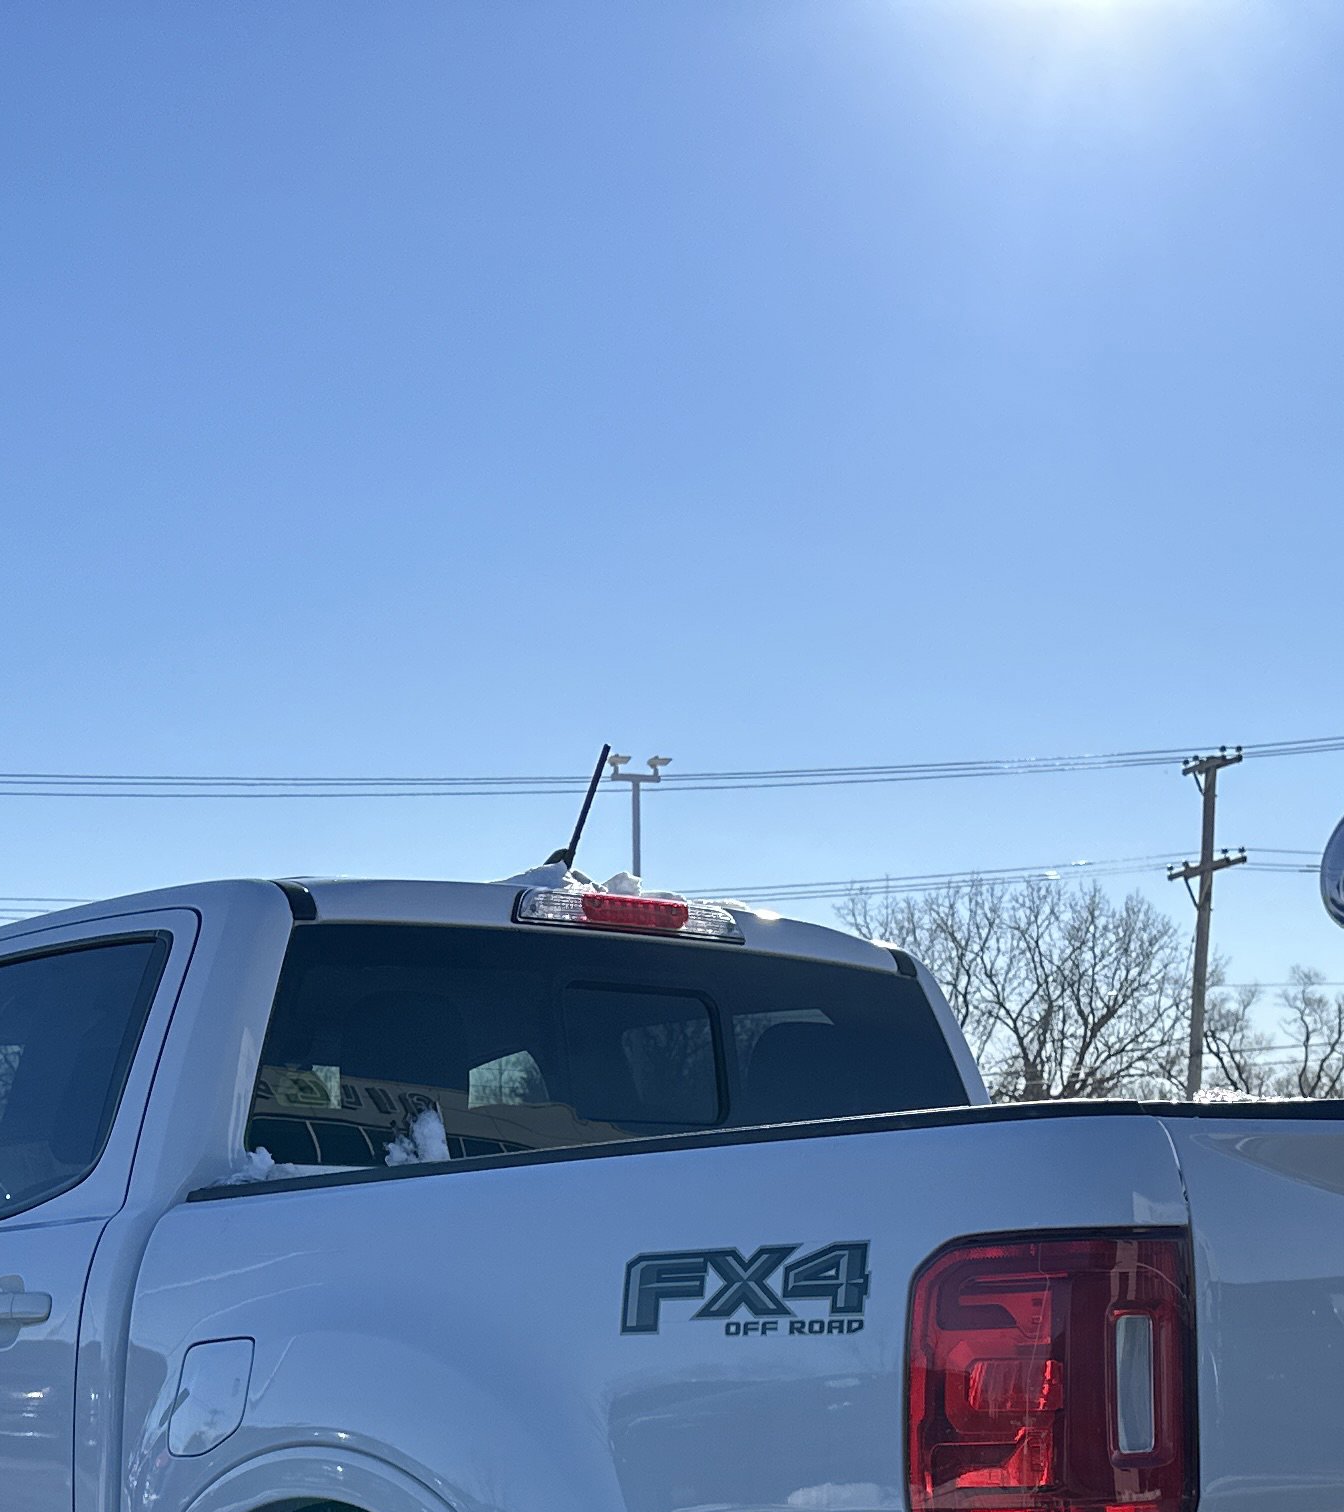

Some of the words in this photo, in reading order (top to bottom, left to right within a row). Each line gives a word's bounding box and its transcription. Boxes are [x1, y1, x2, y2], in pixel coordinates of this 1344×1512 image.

[620, 1240, 872, 1336] FX4
[724, 1320, 779, 1337] OFF
[788, 1318, 865, 1336] ROAD
